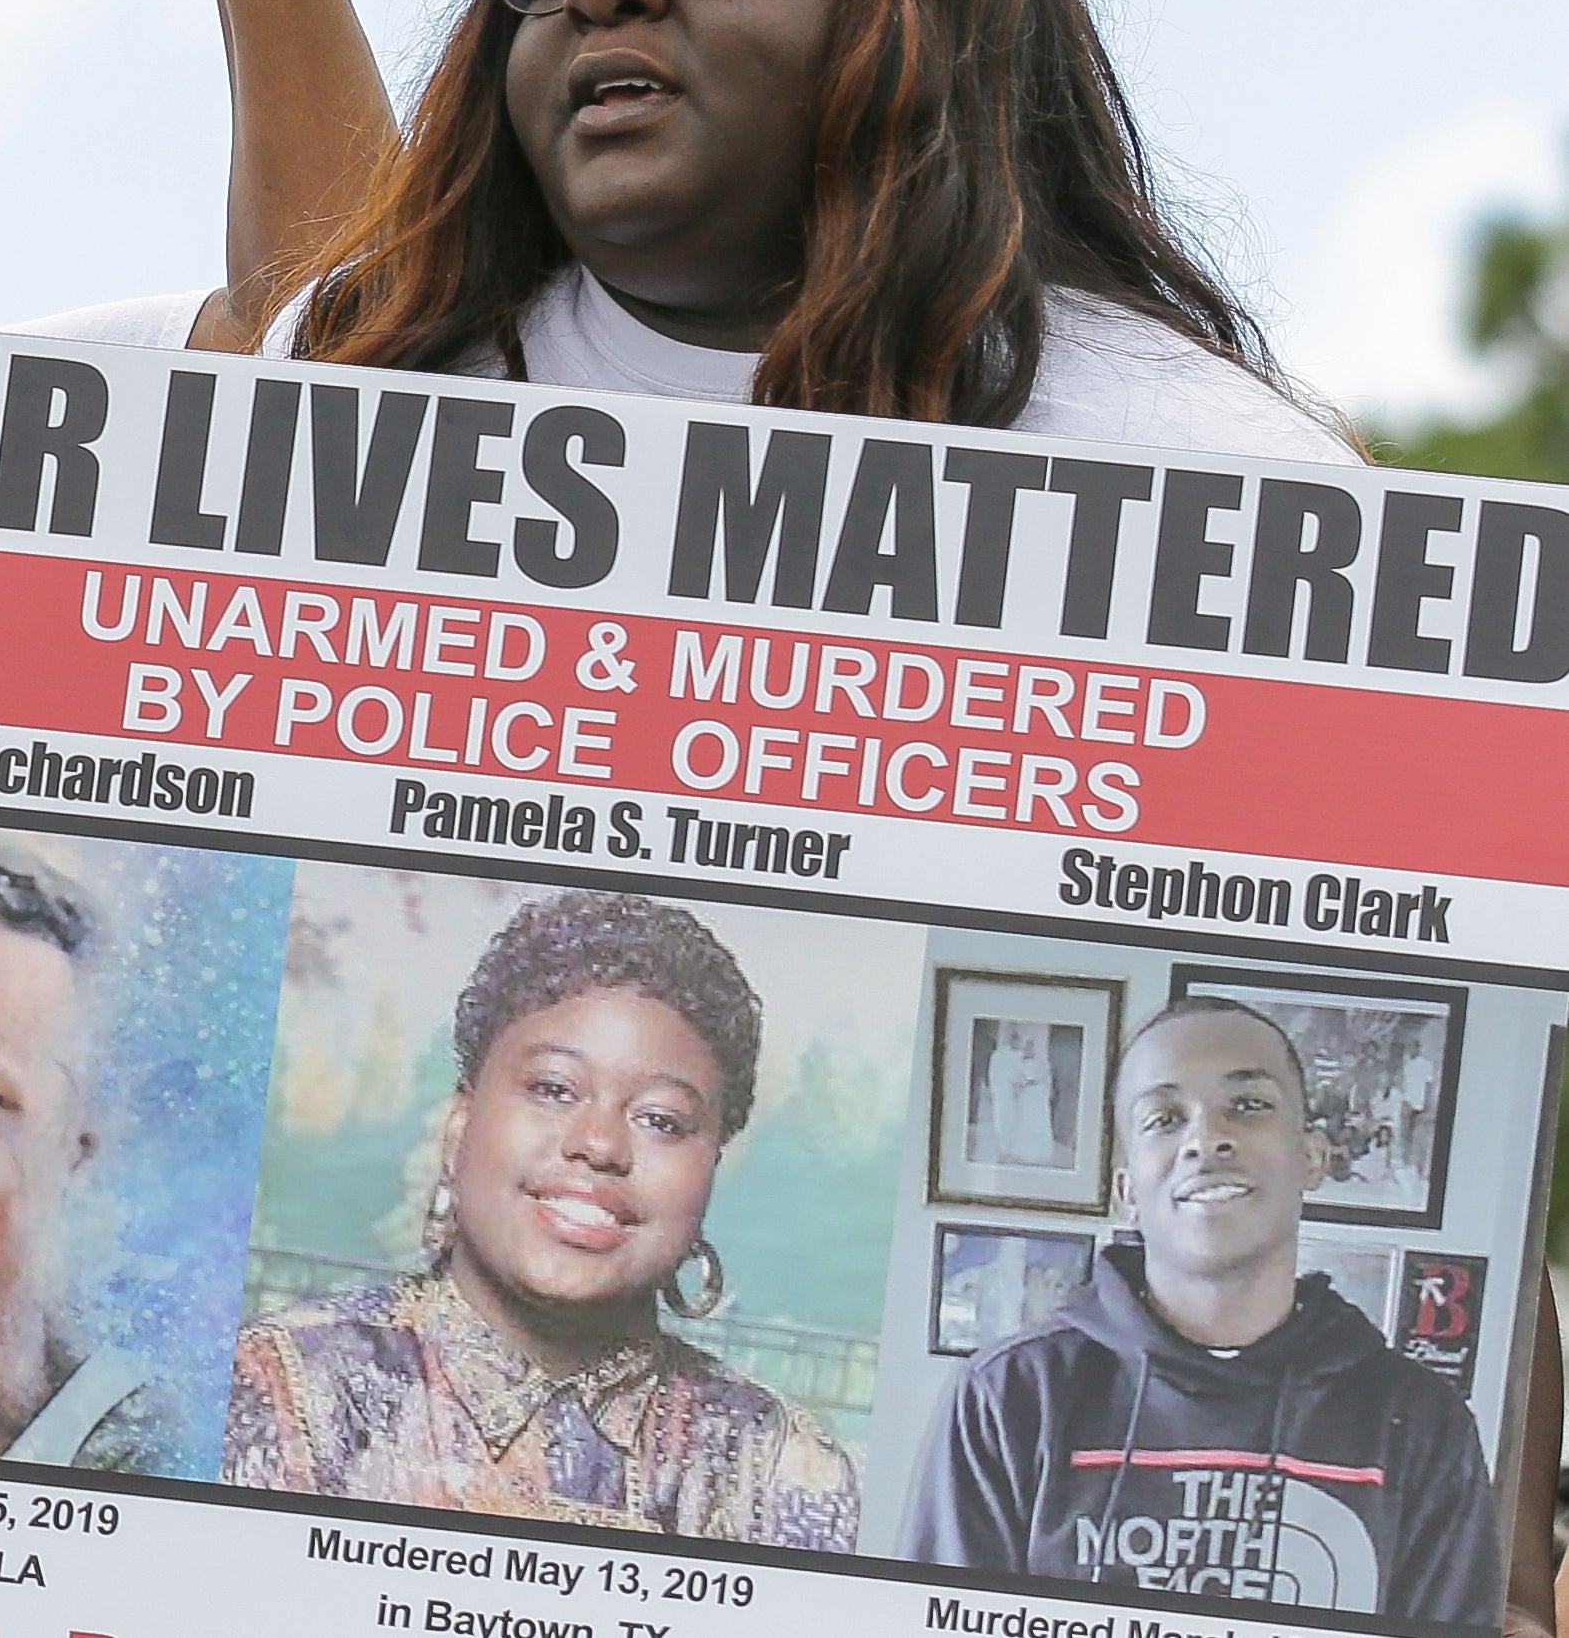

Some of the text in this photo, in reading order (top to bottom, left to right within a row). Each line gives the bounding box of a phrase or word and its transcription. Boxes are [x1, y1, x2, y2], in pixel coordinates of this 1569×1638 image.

[148, 369, 626, 589] LIVES
[666, 421, 1569, 684] MATTERED
[80, 570, 1207, 750] UNARMED & MURDERED
[121, 663, 1142, 834] BY POLICE OFFICERS
[389, 778, 852, 880] Pamela S. Turner
[1057, 848, 1452, 945] Stephon Clark
[28, 1496, 121, 1536] 2019
[1172, 1470, 1284, 1520] THE
[306, 1526, 755, 1608] Murdered May 13, 2019
[1075, 1516, 1276, 1570] NORTH
[377, 1594, 411, 1627] in
